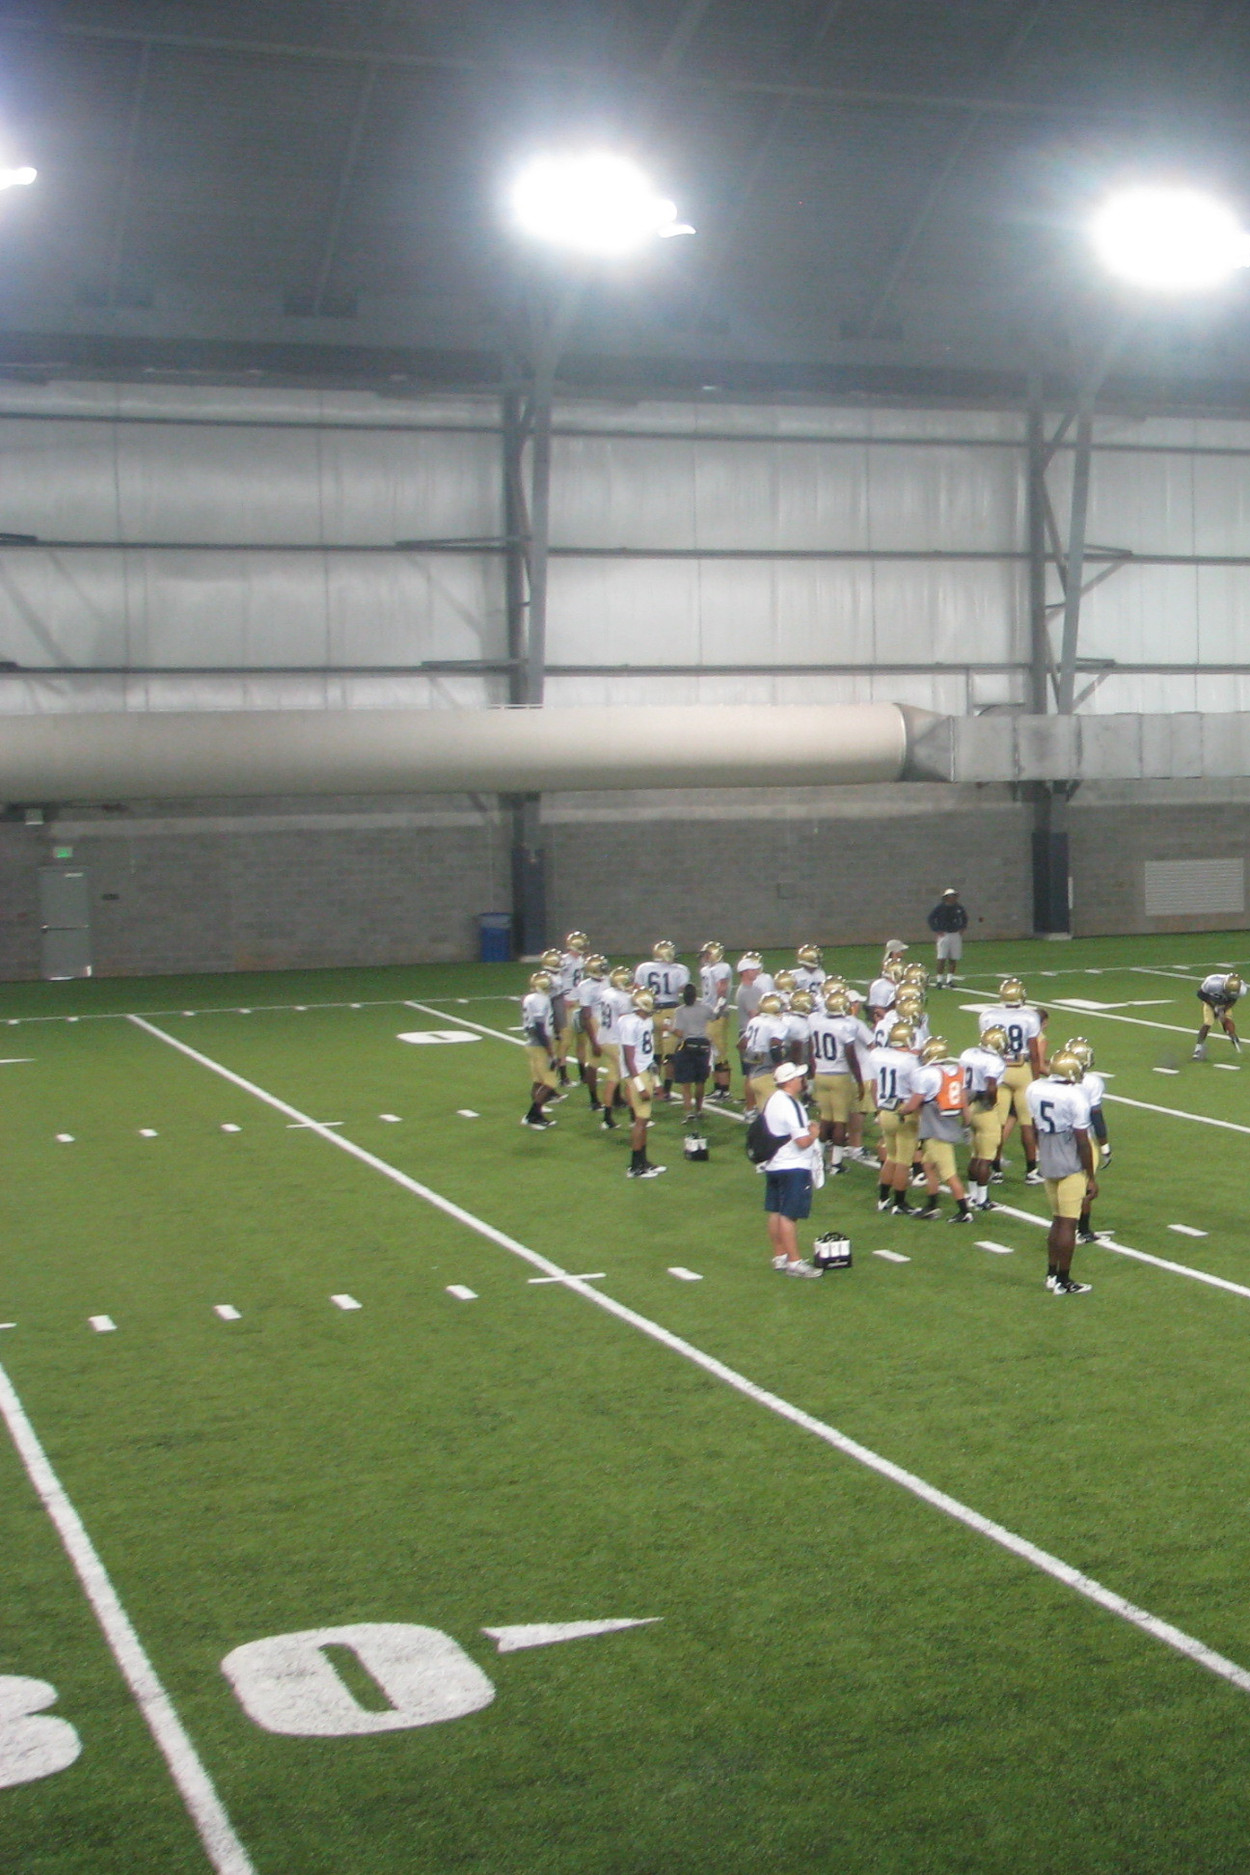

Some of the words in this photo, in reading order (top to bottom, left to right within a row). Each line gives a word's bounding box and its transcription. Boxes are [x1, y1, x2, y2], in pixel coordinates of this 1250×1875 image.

[647, 971, 672, 996] 61
[812, 1029, 837, 1061] 10
[879, 1066, 897, 1099] 11
[1040, 1100, 1056, 1134] 5
